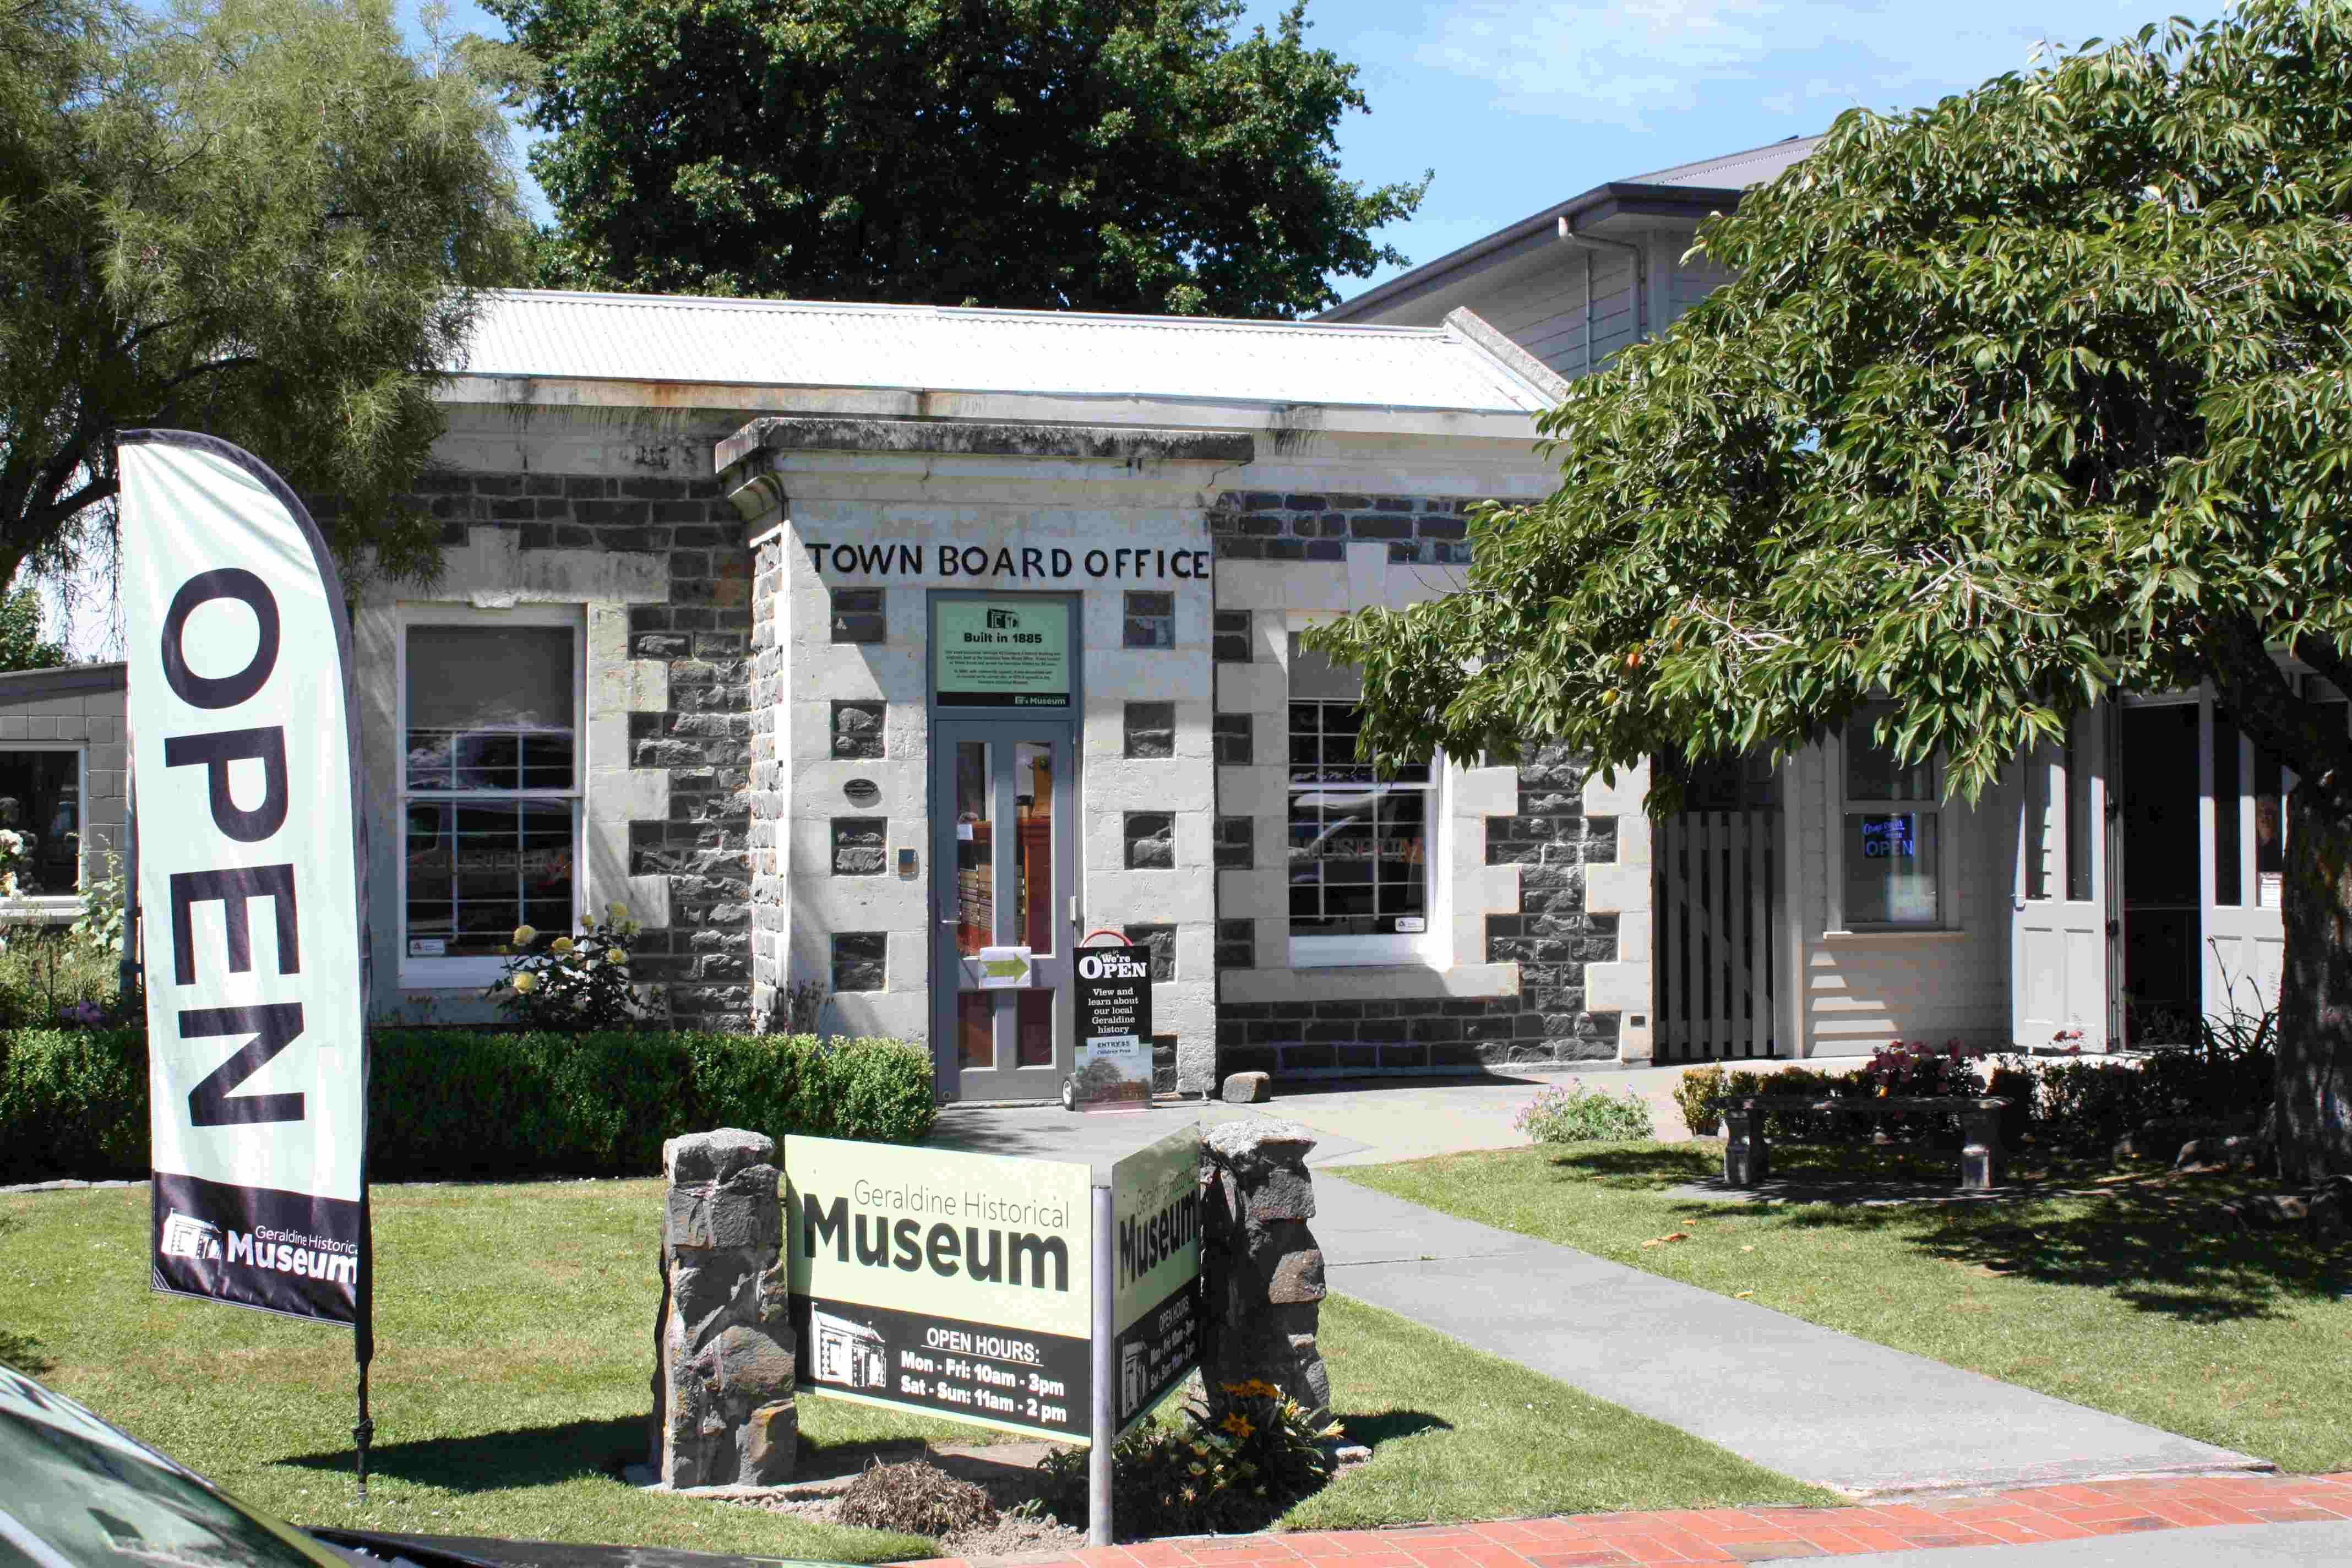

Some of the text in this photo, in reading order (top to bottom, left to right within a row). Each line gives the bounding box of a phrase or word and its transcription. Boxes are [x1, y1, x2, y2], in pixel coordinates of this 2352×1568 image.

[805, 543, 1210, 579] TOWN BOARD OFFICE
[963, 632, 1042, 643] Built in 1885
[1030, 696, 1065, 705] Museum
[161, 568, 305, 1127] OPEN
[1867, 840, 1913, 855] OPEN
[1079, 955, 1147, 979] OPEN
[1101, 954, 1131, 963] We're
[1114, 997, 1139, 1005] about
[1092, 1016, 1135, 1025] Geraldine
[1097, 1026, 1129, 1034] history
[854, 1179, 1069, 1229] Geraldine Historical
[255, 1225, 307, 1246] Geraldine
[804, 1193, 1069, 1292] Museum
[1120, 1189, 1198, 1291] Museum
[227, 1229, 357, 1284] Museum
[927, 1327, 1039, 1363] OPEN HOURS:
[901, 1351, 934, 1372] Mon
[946, 1358, 971, 1379] Fri:
[974, 1363, 1016, 1387] 10am
[1028, 1373, 1064, 1397] 3pm
[901, 1375, 925, 1396] Sat
[938, 1381, 971, 1404] Sun:
[974, 1389, 1014, 1412] 11am
[1027, 1398, 1038, 1417] 2
[1041, 1405, 1066, 1423] pm
